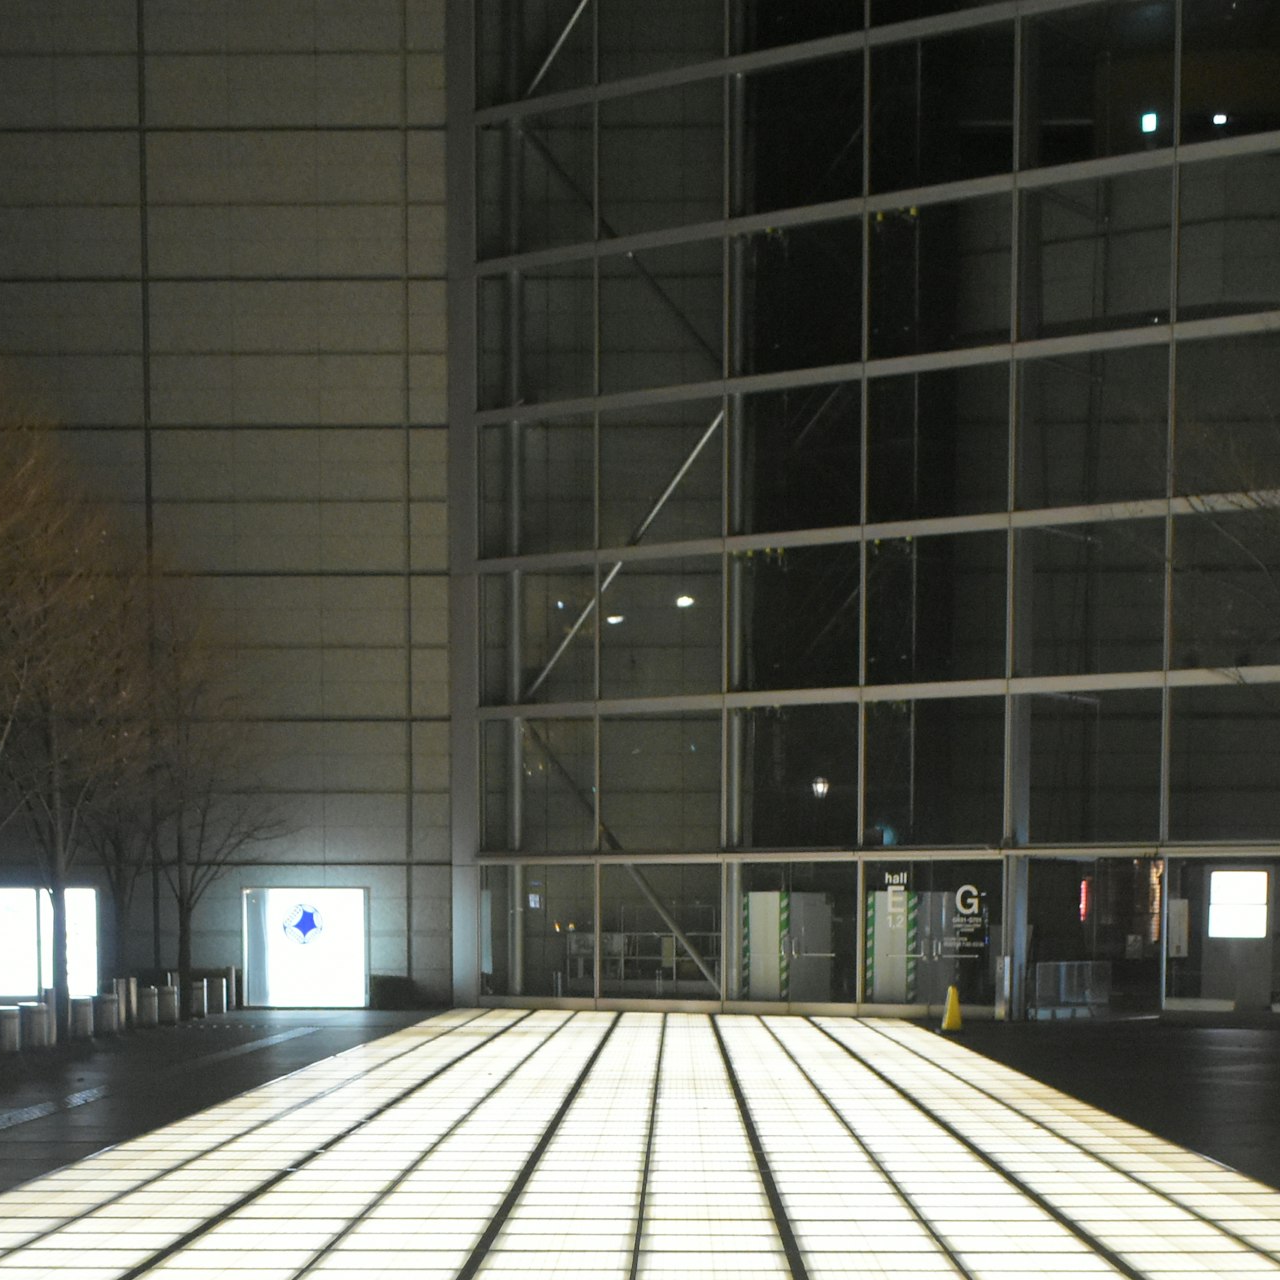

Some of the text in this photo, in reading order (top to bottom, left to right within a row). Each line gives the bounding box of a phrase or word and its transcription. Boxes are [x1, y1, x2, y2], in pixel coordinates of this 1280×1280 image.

[885, 872, 908, 884] hall
[887, 885, 905, 913] E
[955, 884, 980, 915] G
